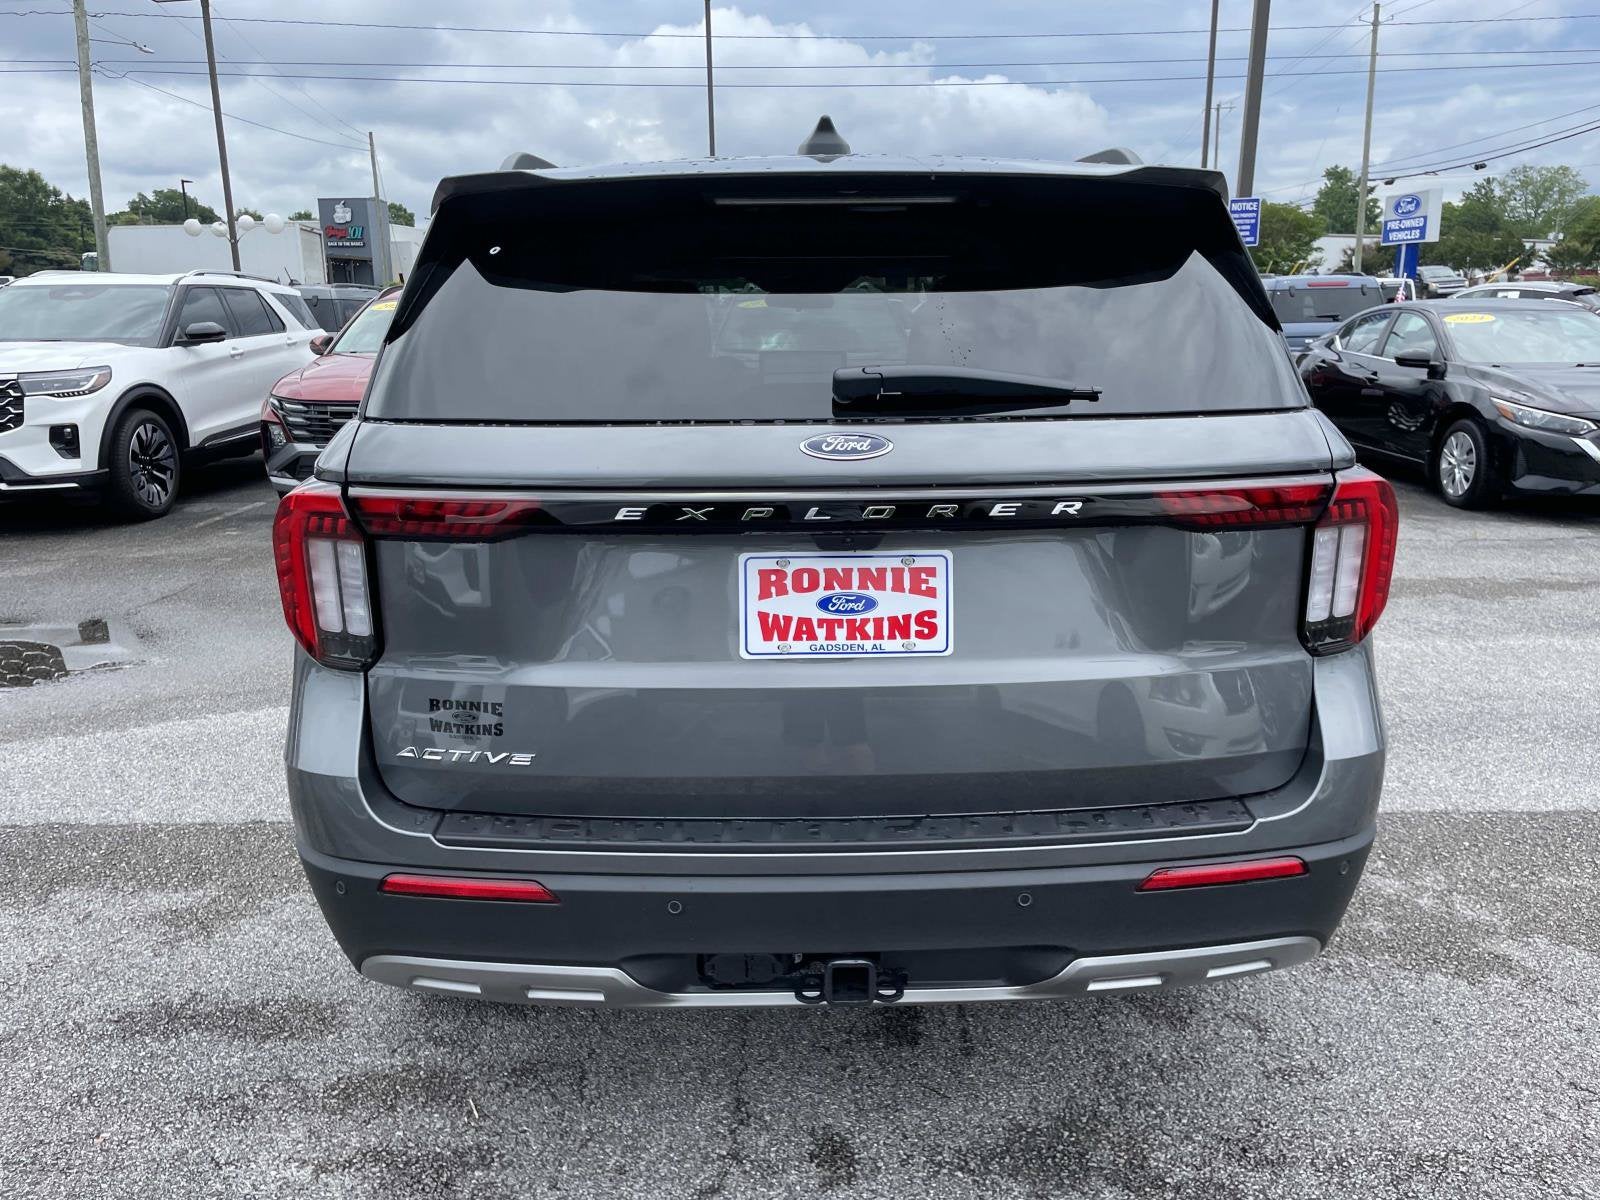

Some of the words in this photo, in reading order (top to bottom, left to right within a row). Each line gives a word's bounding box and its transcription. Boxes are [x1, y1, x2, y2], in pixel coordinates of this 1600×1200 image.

[1231, 202, 1258, 211] NOTICE
[1387, 217, 1424, 230] PRE-OWNED
[346, 226, 364, 239] 101
[1389, 229, 1420, 241] VEHICLES
[821, 436, 871, 451] Ford
[614, 501, 1084, 521] EXPLORER
[757, 566, 938, 601] RONNIE
[828, 596, 866, 612] Ford
[757, 609, 939, 642] WATKINS
[809, 643, 868, 653] GADSDEN,
[871, 643, 886, 651] AL
[428, 698, 503, 718] RONNIE
[428, 717, 504, 737] WATKINS
[396, 746, 537, 766] ACTIVE
